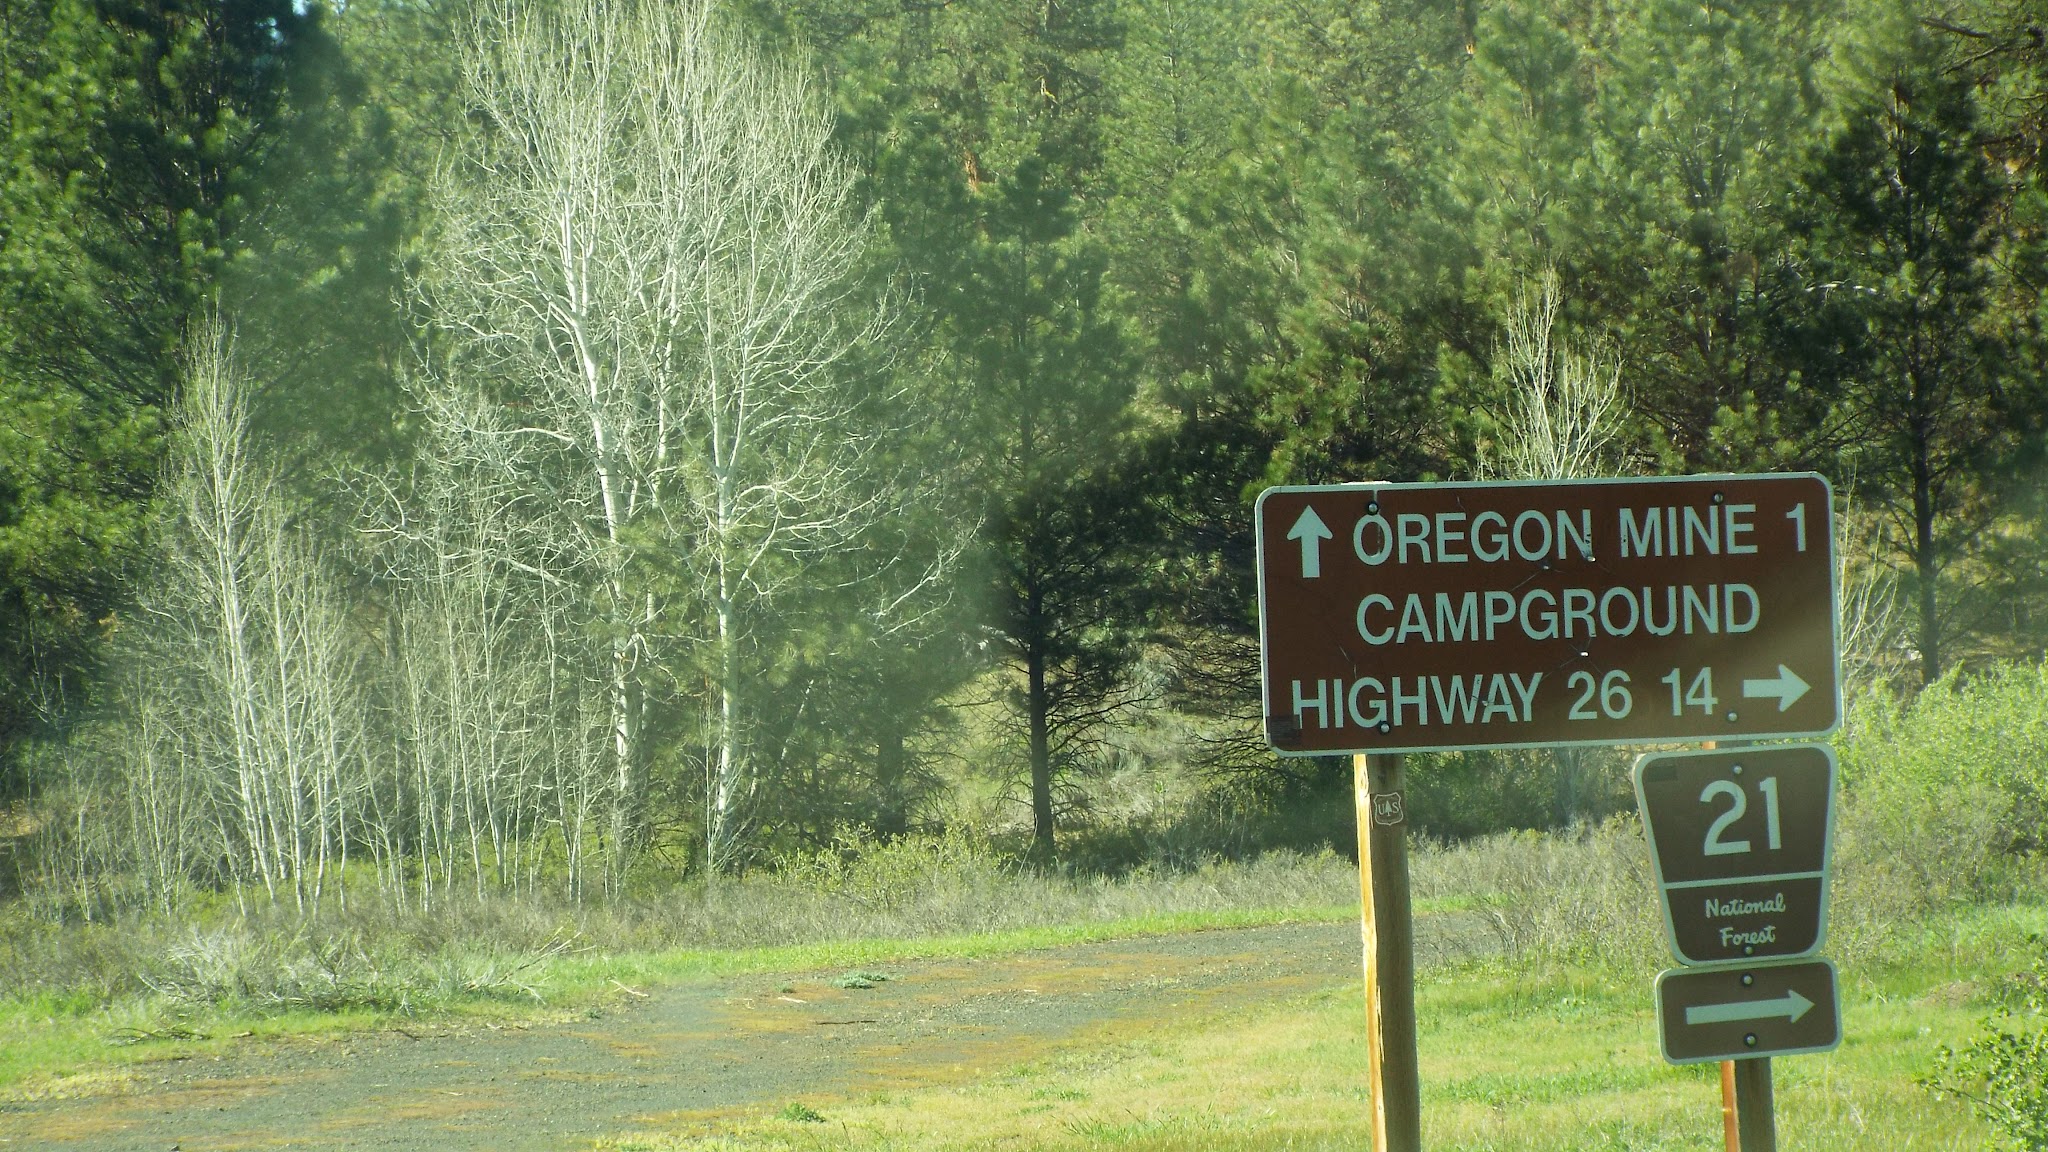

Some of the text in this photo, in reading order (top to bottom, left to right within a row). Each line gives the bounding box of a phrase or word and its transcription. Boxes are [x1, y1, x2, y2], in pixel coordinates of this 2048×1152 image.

[1353, 502, 1807, 565] OREGON MINE 1
[1356, 583, 1761, 646] CAMPGROUND
[1291, 667, 1718, 730] HIGHWAY 26 14
[1700, 777, 1781, 856] 21
[1705, 893, 1786, 918] National
[1719, 925, 1776, 947] Forest
